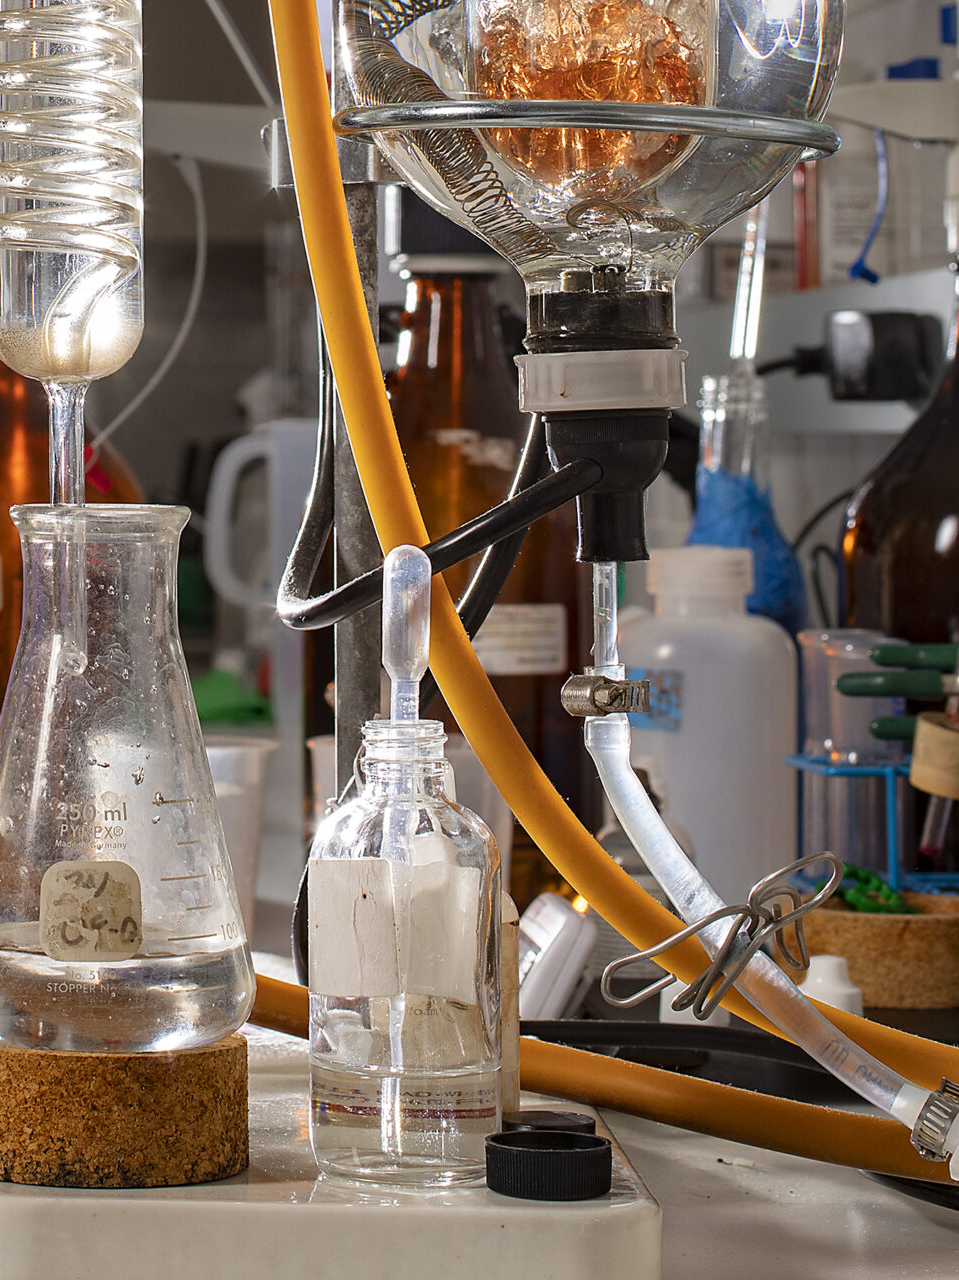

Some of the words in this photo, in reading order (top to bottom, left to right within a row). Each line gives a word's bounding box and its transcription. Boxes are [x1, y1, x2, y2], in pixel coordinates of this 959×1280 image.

[56, 803, 97, 821] 250
[104, 802, 128, 821] ml
[220, 921, 239, 941] 100
[46, 982, 96, 994] STOPPER
